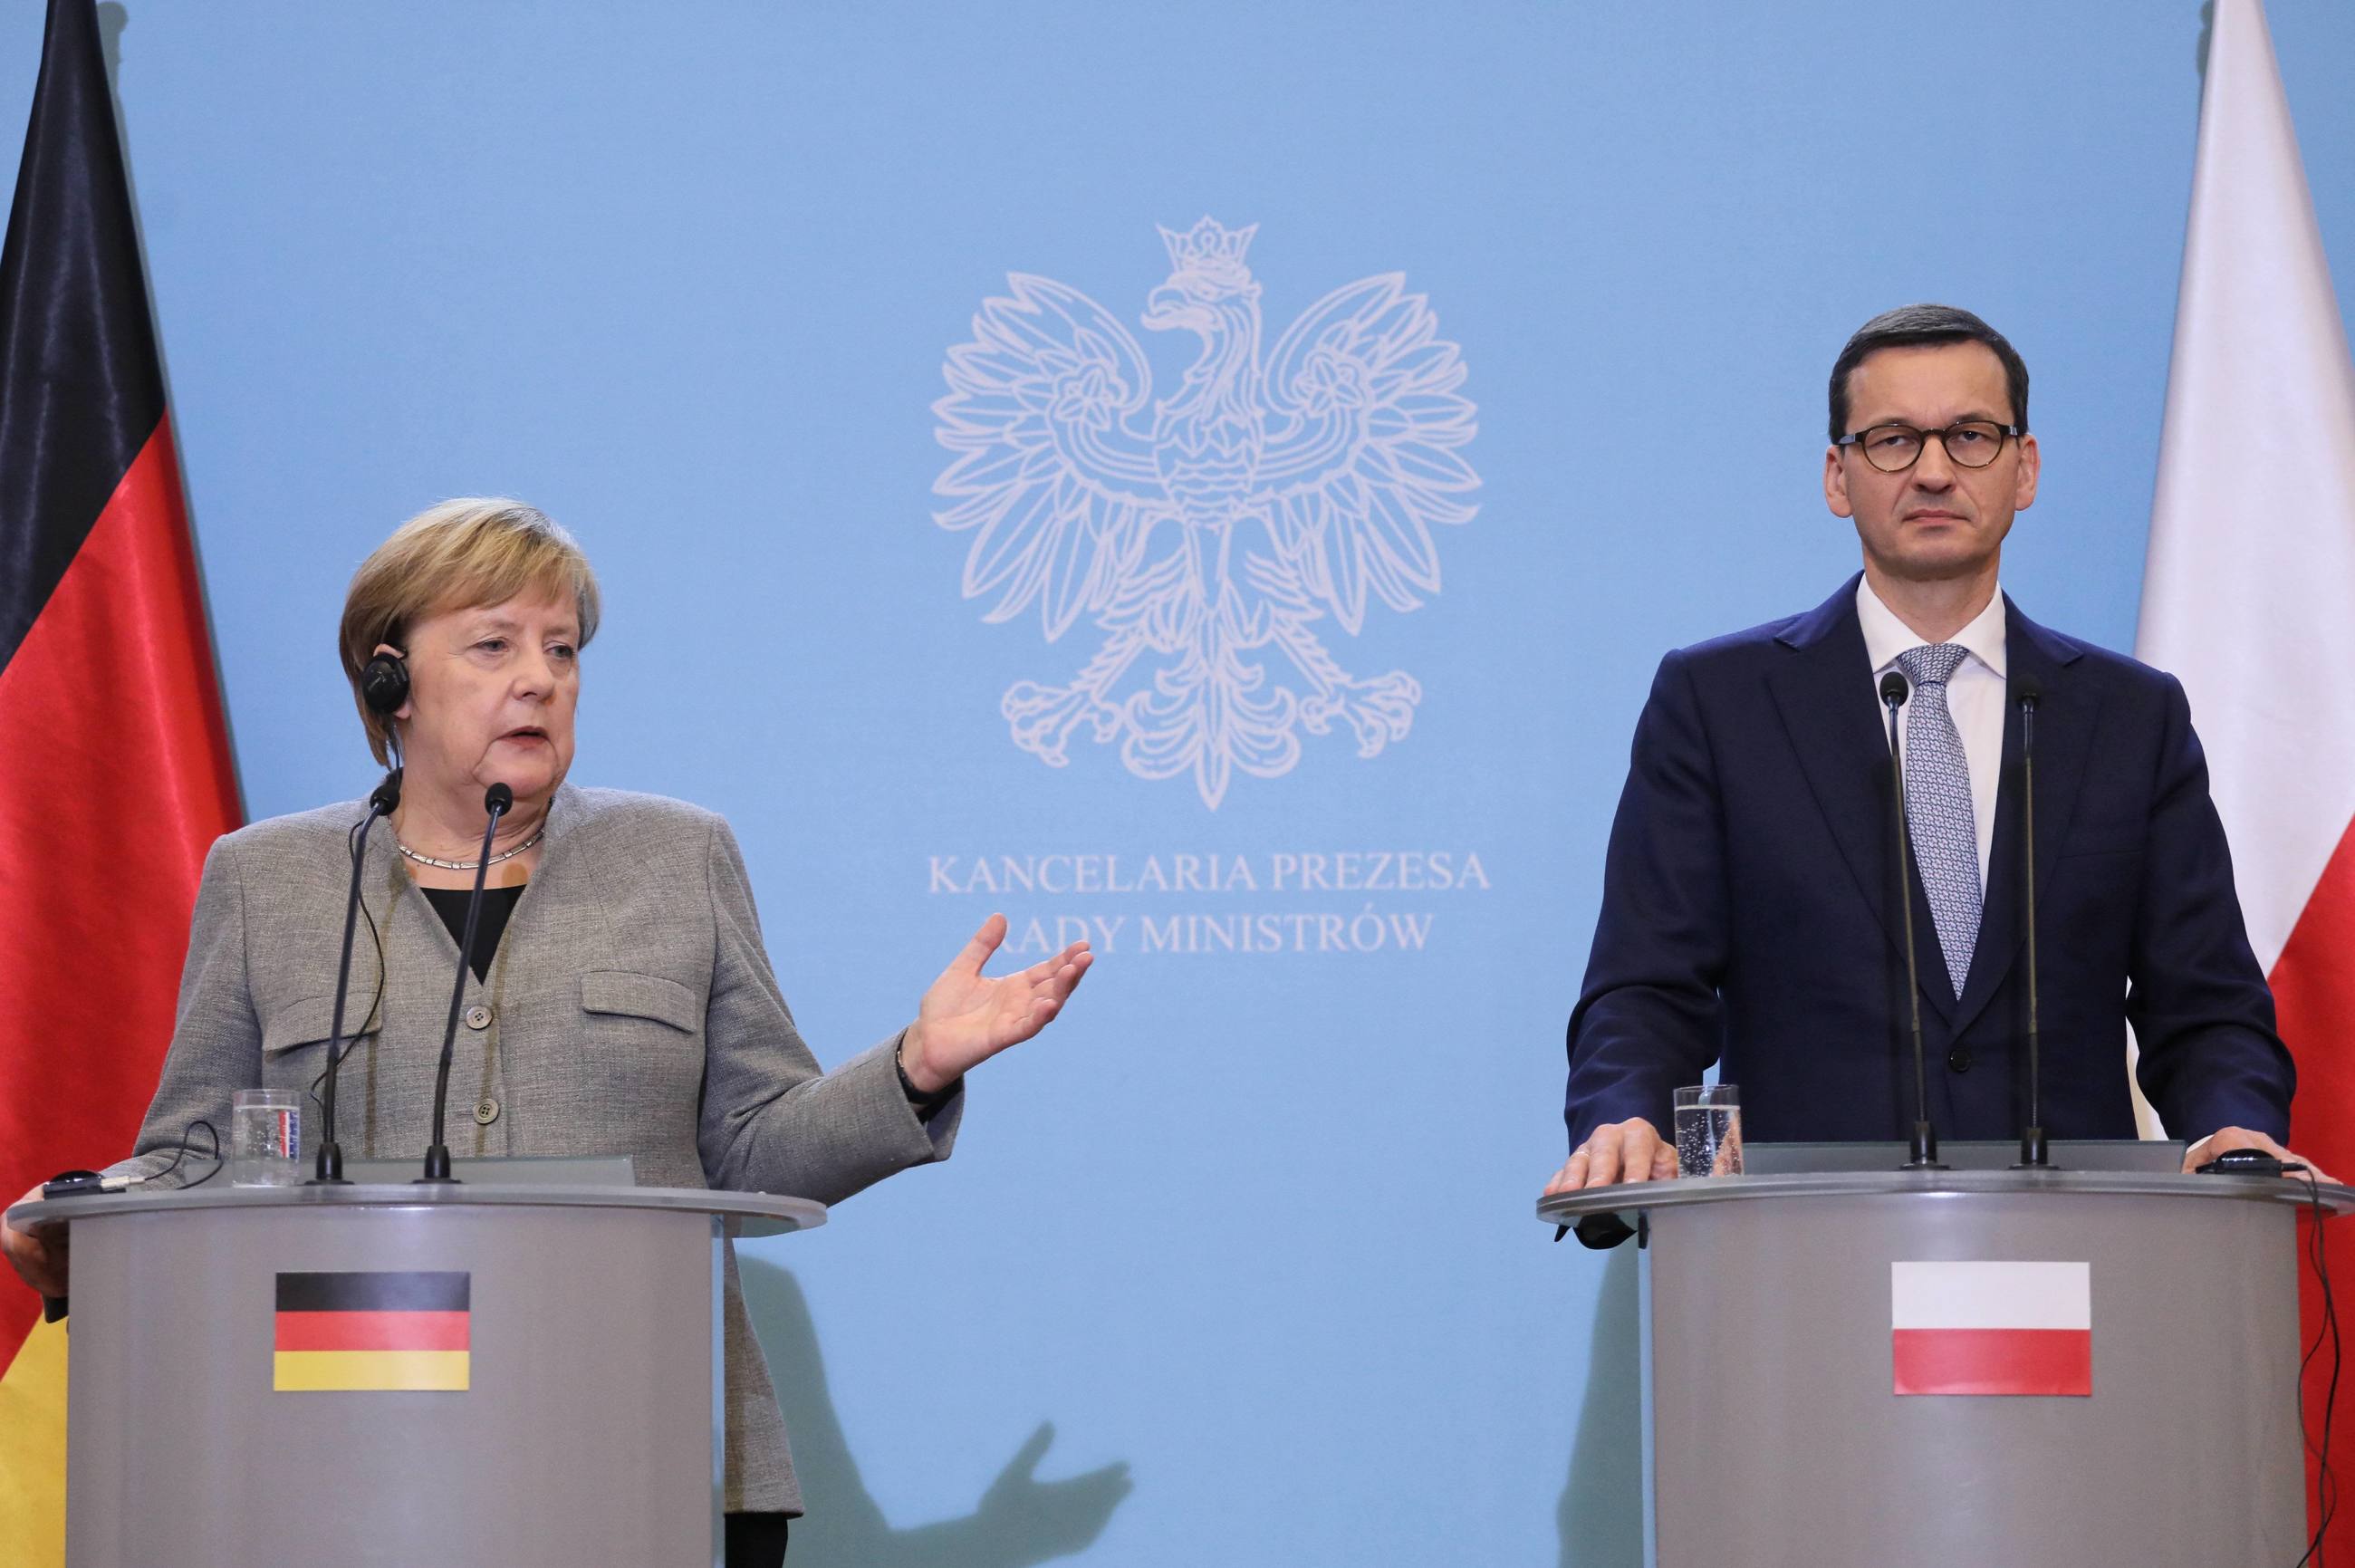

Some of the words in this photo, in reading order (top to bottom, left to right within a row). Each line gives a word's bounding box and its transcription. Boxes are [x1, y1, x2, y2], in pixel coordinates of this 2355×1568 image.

[928, 853, 1258, 893] KANCELARIA
[1271, 851, 1491, 891] PREZESA
[1000, 915, 1127, 953] ADY
[1140, 902, 1436, 954] MINISTRÓW
